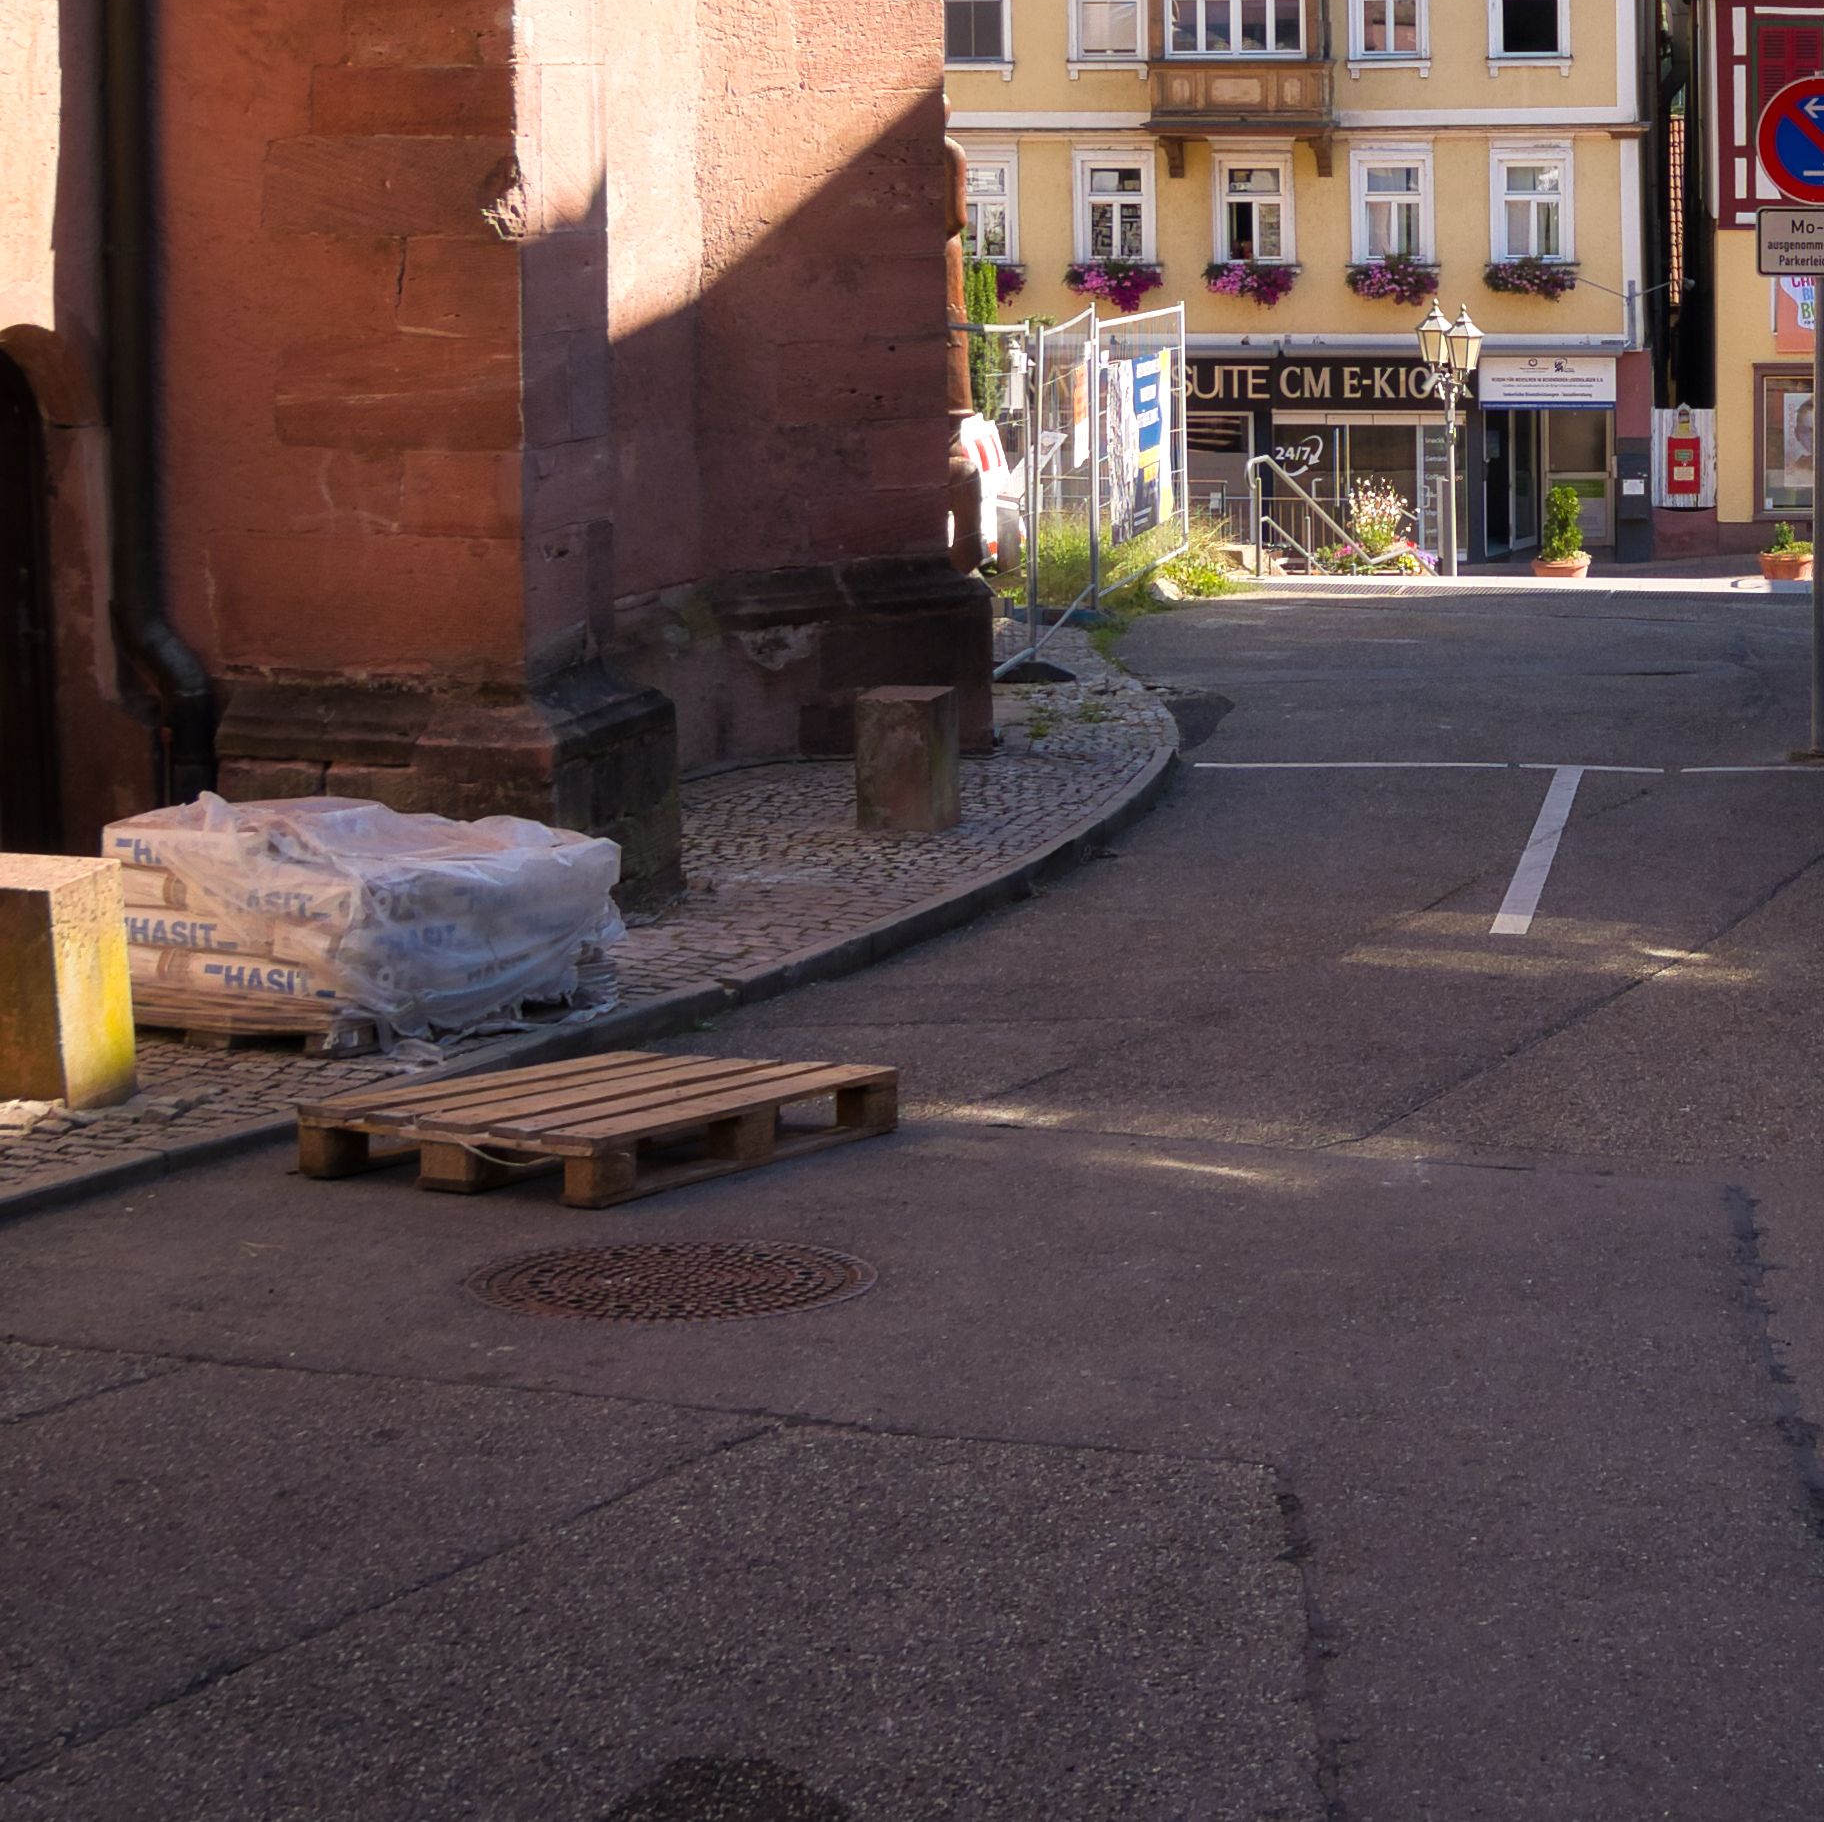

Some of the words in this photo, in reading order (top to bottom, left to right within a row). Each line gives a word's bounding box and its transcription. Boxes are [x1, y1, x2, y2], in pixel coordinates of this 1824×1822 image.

[1279, 366, 1331, 399] CM
[1275, 445, 1312, 461] 24/7
[130, 916, 218, 949] HASIT
[223, 964, 310, 997] HASIT
